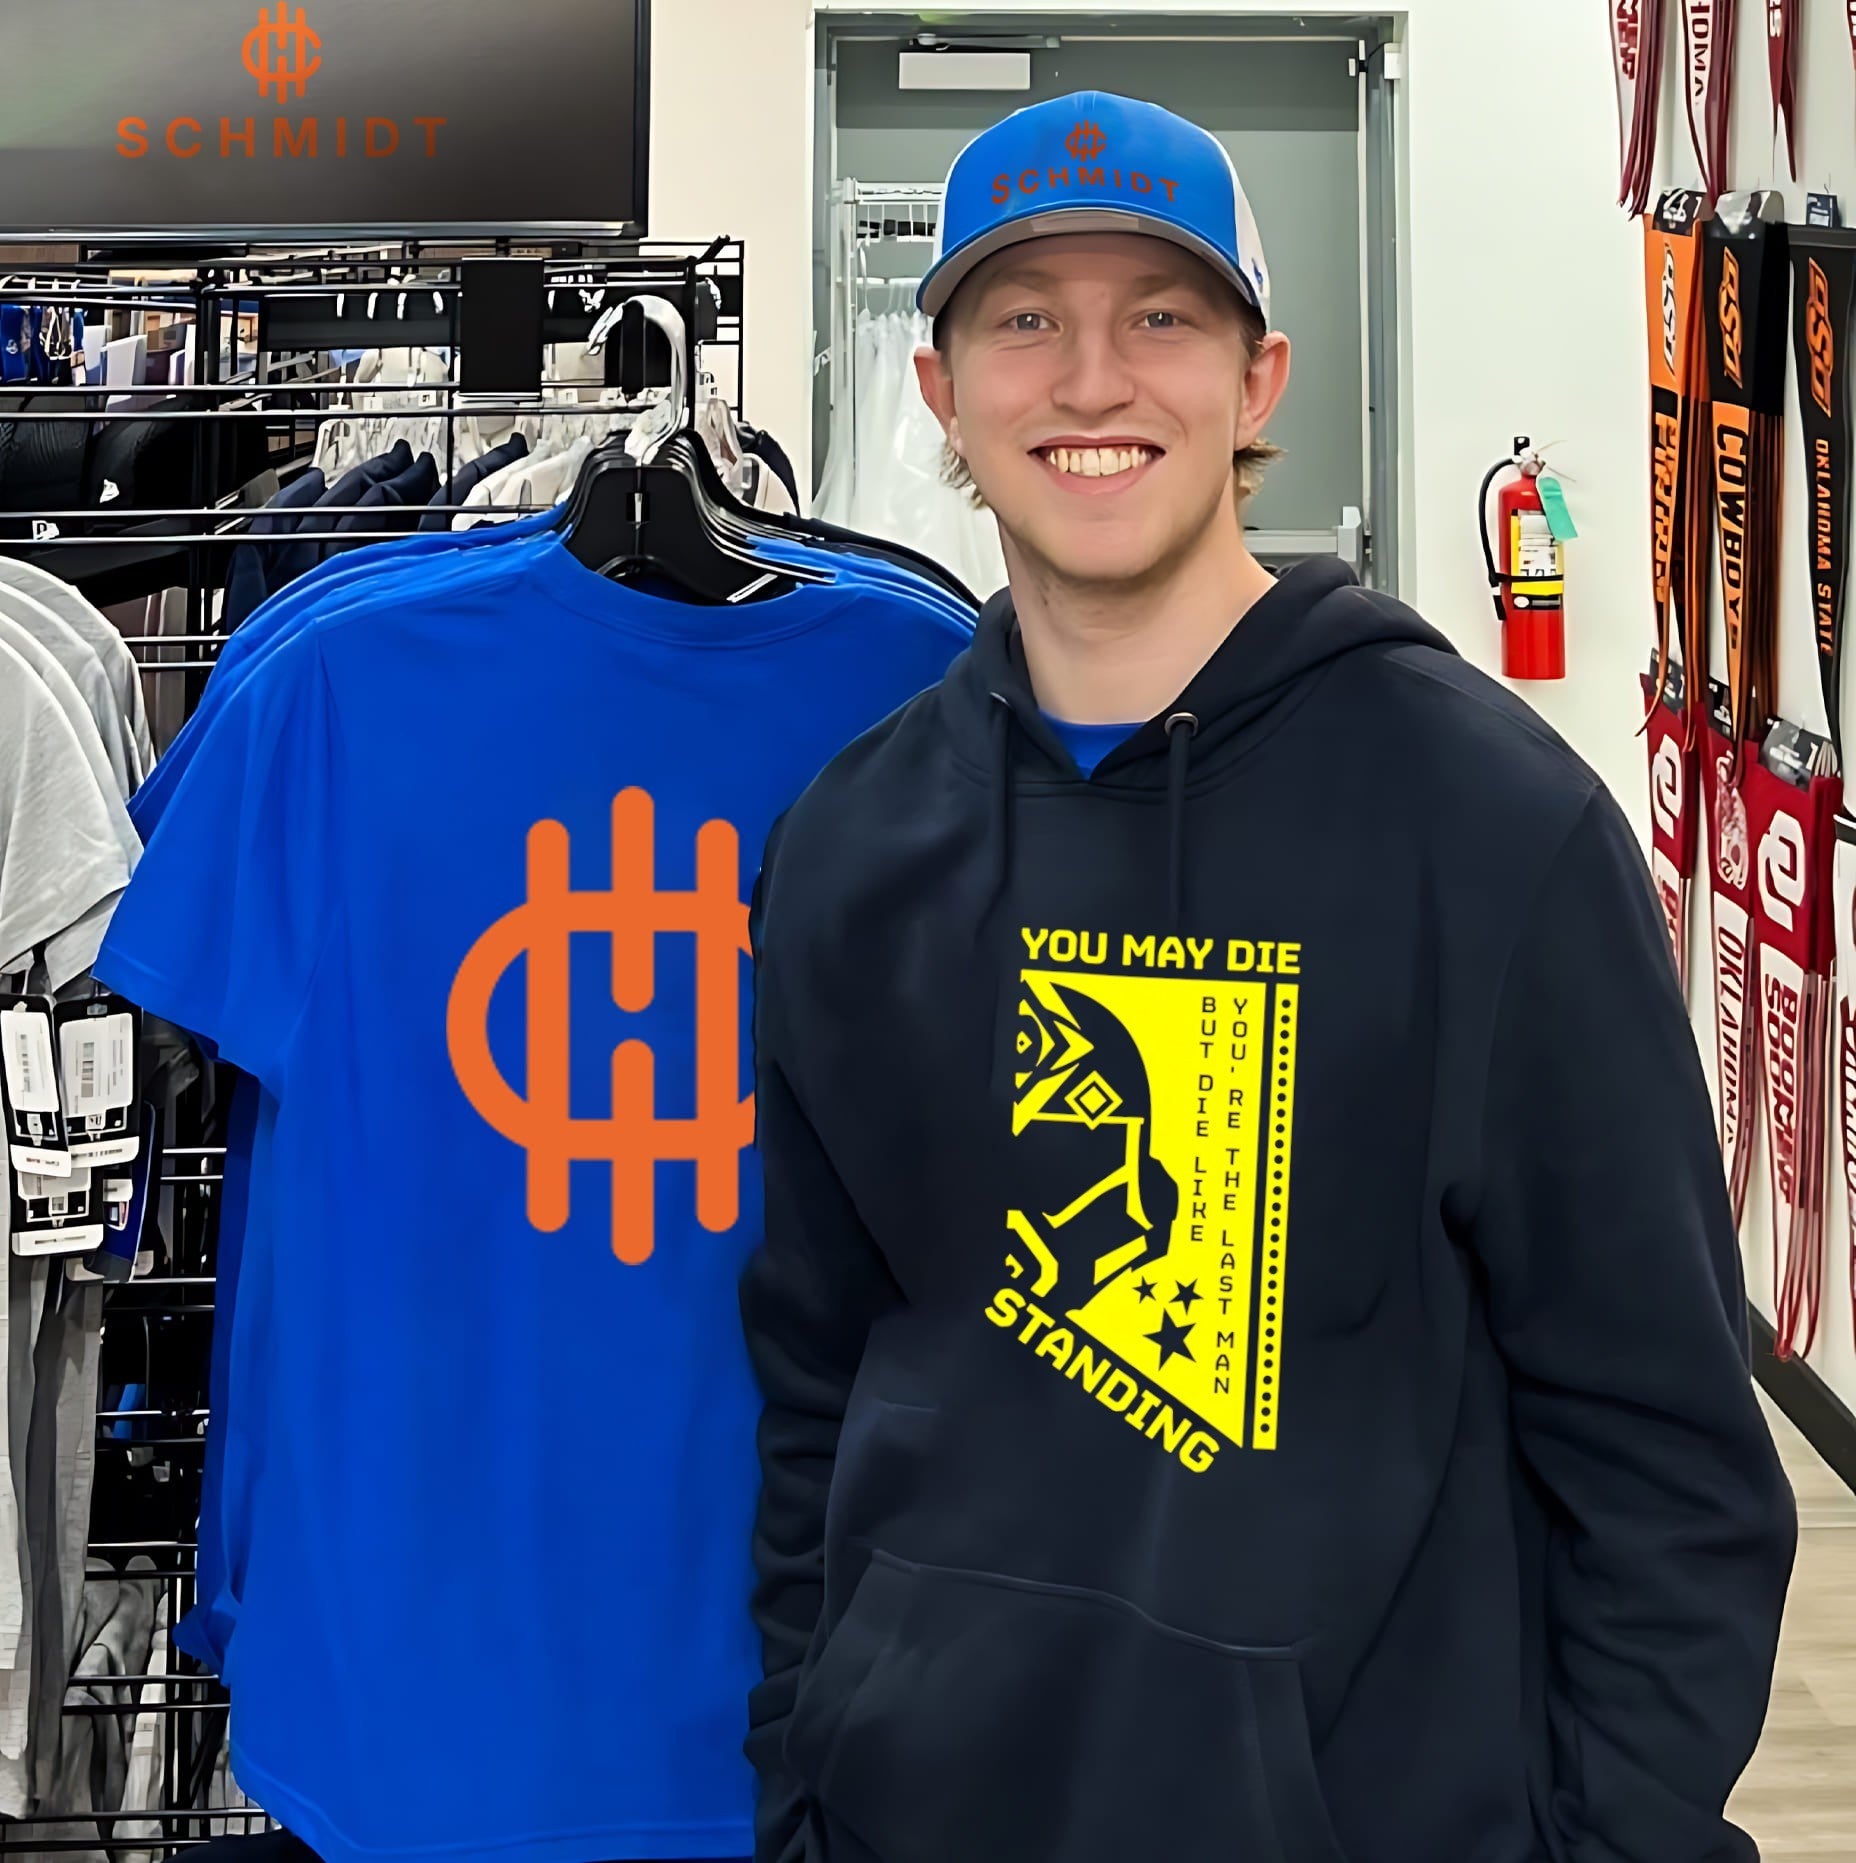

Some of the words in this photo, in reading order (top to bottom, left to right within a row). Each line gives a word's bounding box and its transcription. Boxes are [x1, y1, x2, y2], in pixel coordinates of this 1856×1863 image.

[116, 116, 447, 158] SCHMIDT
[991, 167, 1180, 205] SCHMIDT
[1815, 438, 1832, 570] OKLAHOMA
[1022, 928, 1107, 964] YOU
[1122, 935, 1213, 969] MAY
[1227, 940, 1301, 974] DIE
[1200, 996, 1216, 1058] BUT
[1227, 998, 1248, 1129] YOU'RE
[1196, 1074, 1213, 1137] DIE
[1191, 1156, 1207, 1242] LIKE
[1223, 1148, 1240, 1211] THE
[1218, 1230, 1235, 1315] LAST
[985, 1288, 1219, 1472] STANDING
[1214, 1331, 1234, 1394] MAN
